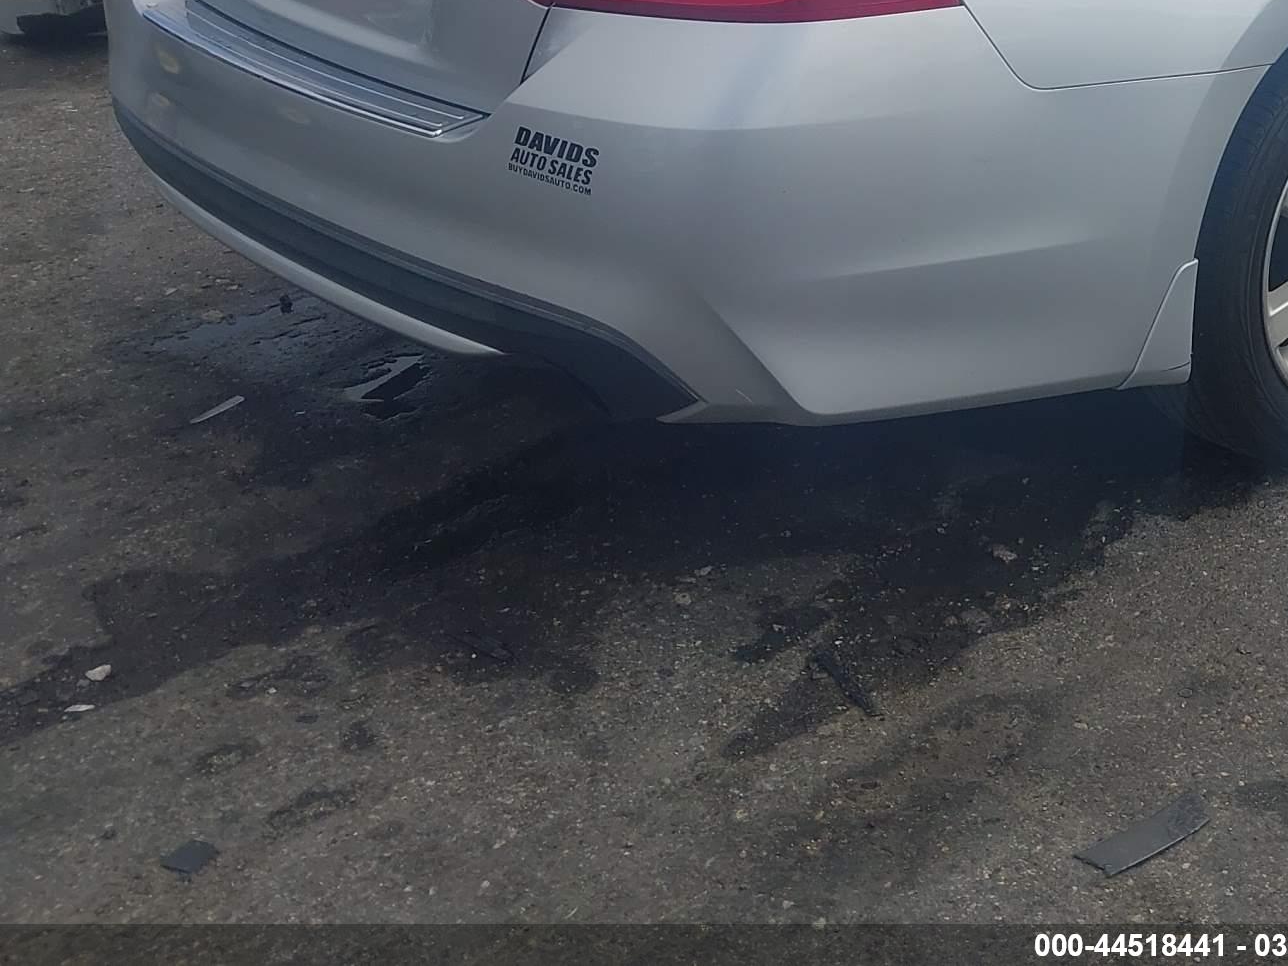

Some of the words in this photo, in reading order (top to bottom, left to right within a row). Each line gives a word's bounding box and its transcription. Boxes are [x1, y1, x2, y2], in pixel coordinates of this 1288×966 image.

[510, 147, 548, 171] AUTO
[547, 159, 593, 185] SALES
[514, 126, 600, 168] DAVIDS
[508, 162, 592, 196] BUYDAVIDSAUTO.COM
